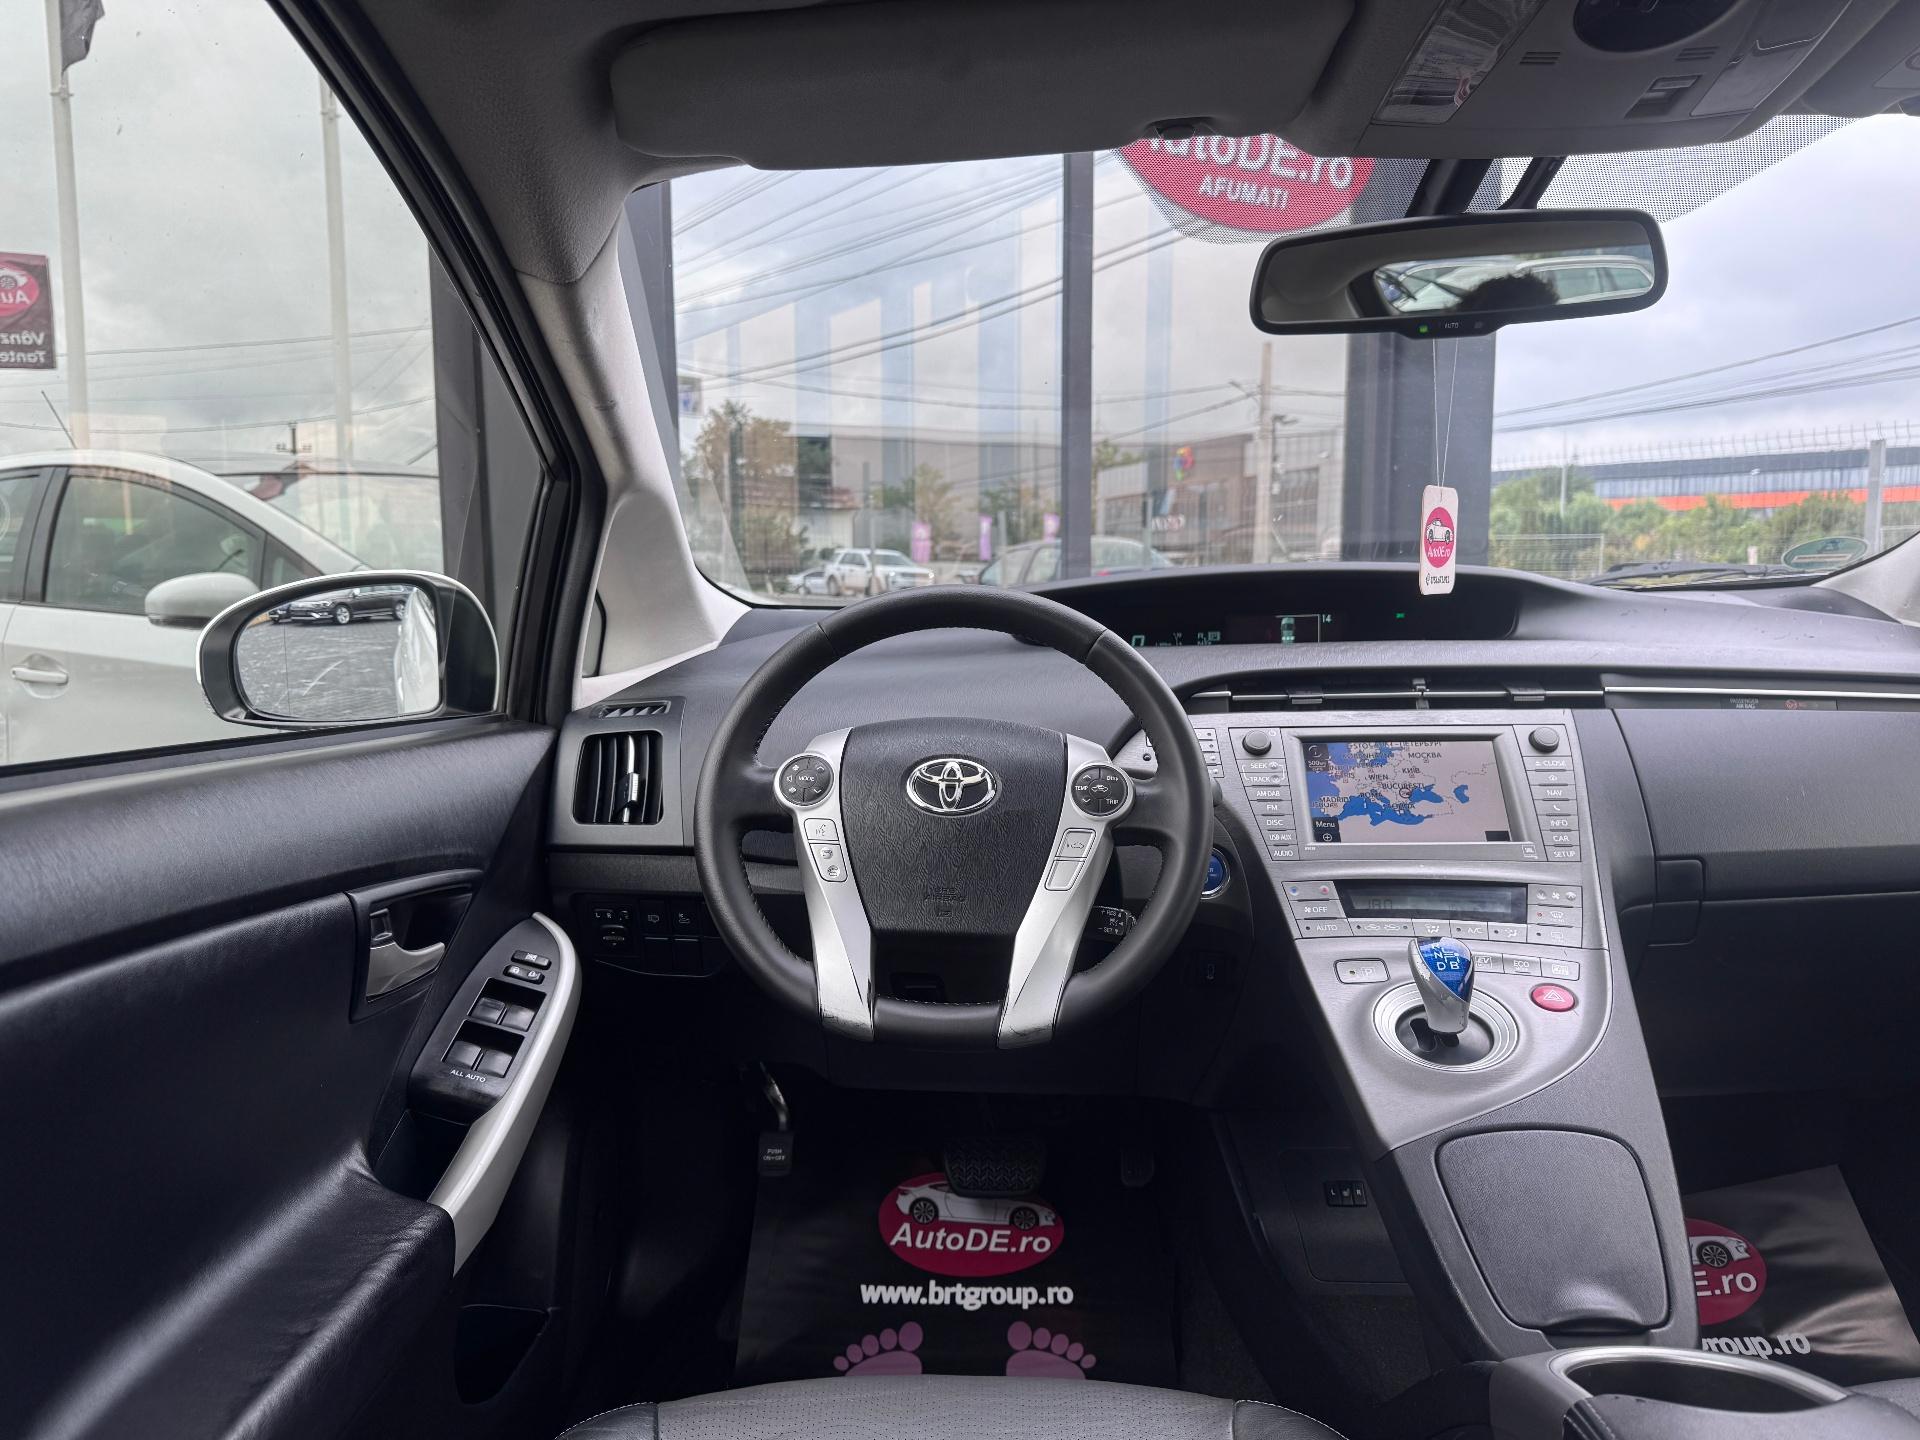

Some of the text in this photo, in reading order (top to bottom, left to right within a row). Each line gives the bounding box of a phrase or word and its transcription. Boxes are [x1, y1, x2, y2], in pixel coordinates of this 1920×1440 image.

[1200, 175, 1289, 210] AFUMATI
[1316, 820, 1335, 828] Menu
[1434, 951, 1443, 959] N
[1437, 961, 1460, 971] D B
[1513, 959, 1530, 968] ECO
[450, 1069, 486, 1083] ALL AUTO
[889, 1222, 1051, 1253] AutoDE.ro
[860, 1279, 1074, 1311] www.brtgroup.ro
